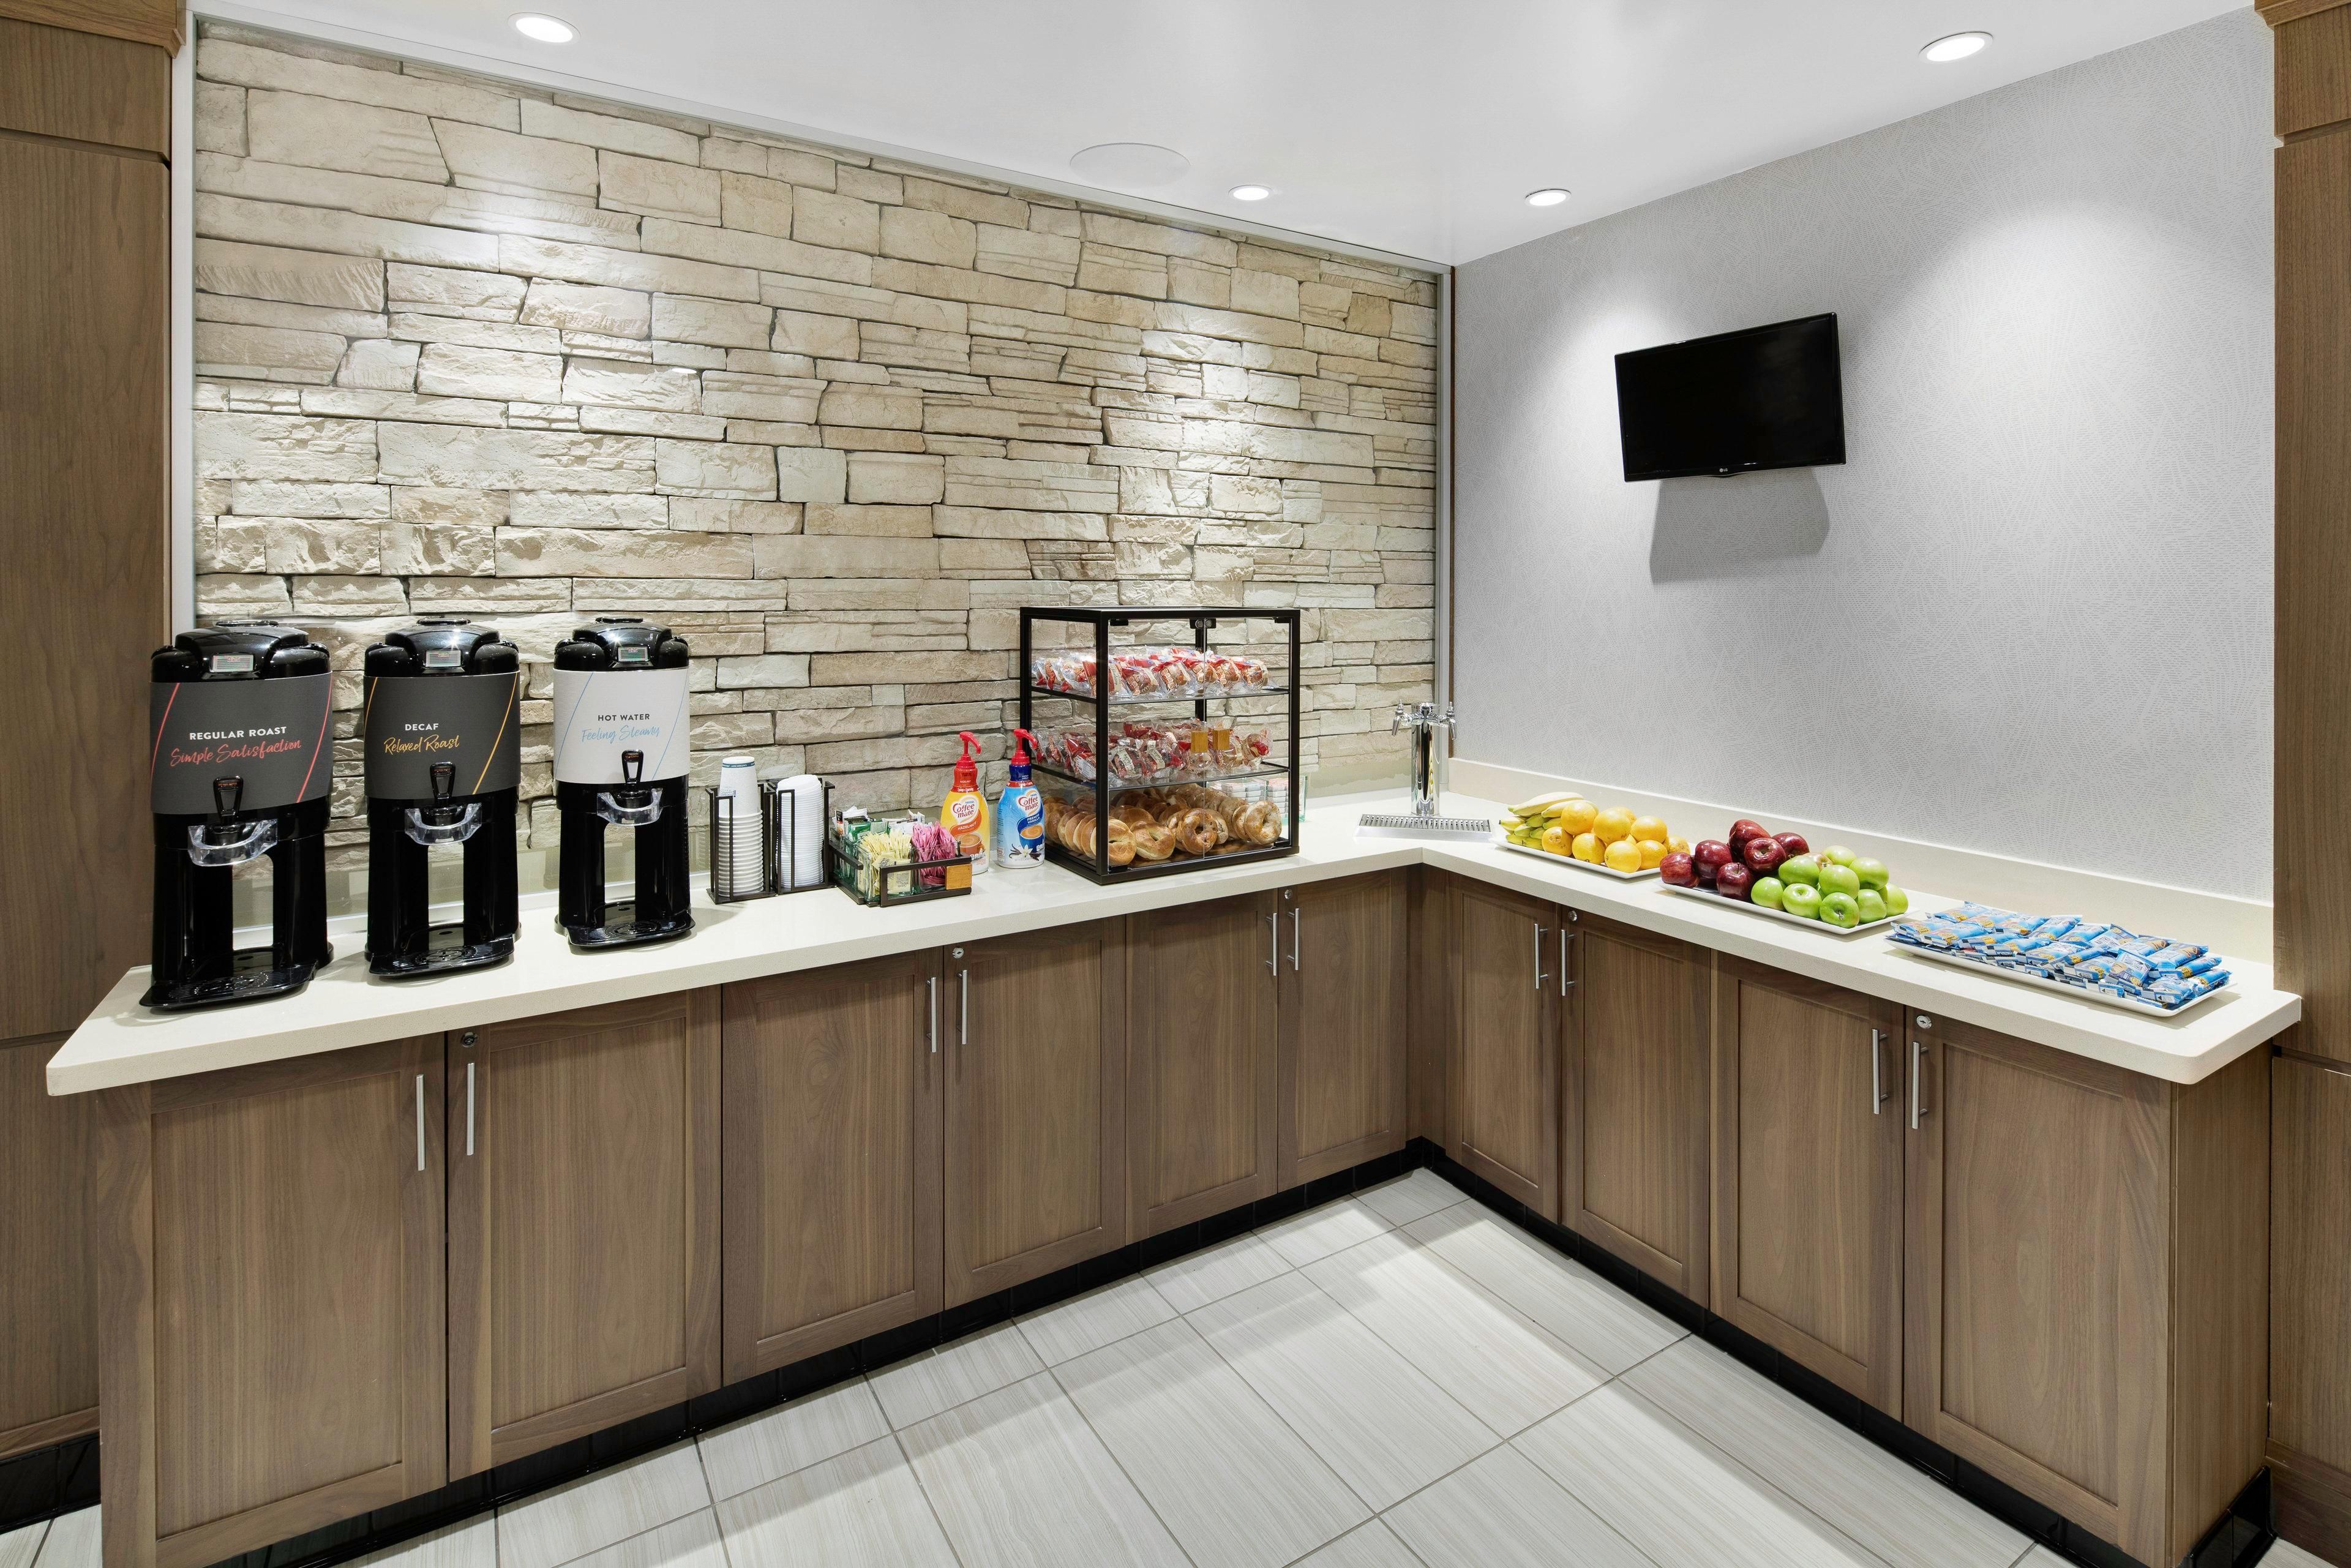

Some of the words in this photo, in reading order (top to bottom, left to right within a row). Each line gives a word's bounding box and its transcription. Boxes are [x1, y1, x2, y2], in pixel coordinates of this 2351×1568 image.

[189, 730, 244, 740] REGULAR
[249, 726, 287, 737] ROAST
[581, 727, 616, 744] Feeling
[619, 724, 660, 741] Steamy
[384, 737, 423, 755] Relaxed
[424, 734, 460, 752] Roast
[170, 747, 214, 767] Simple
[216, 738, 302, 763] Satisfaction
[1018, 796, 1038, 807] Coffee
[1025, 802, 1038, 811] mate
[953, 803, 975, 814] Coffee
[958, 809, 974, 818] mate
[957, 821, 977, 830] HAZELNUT
